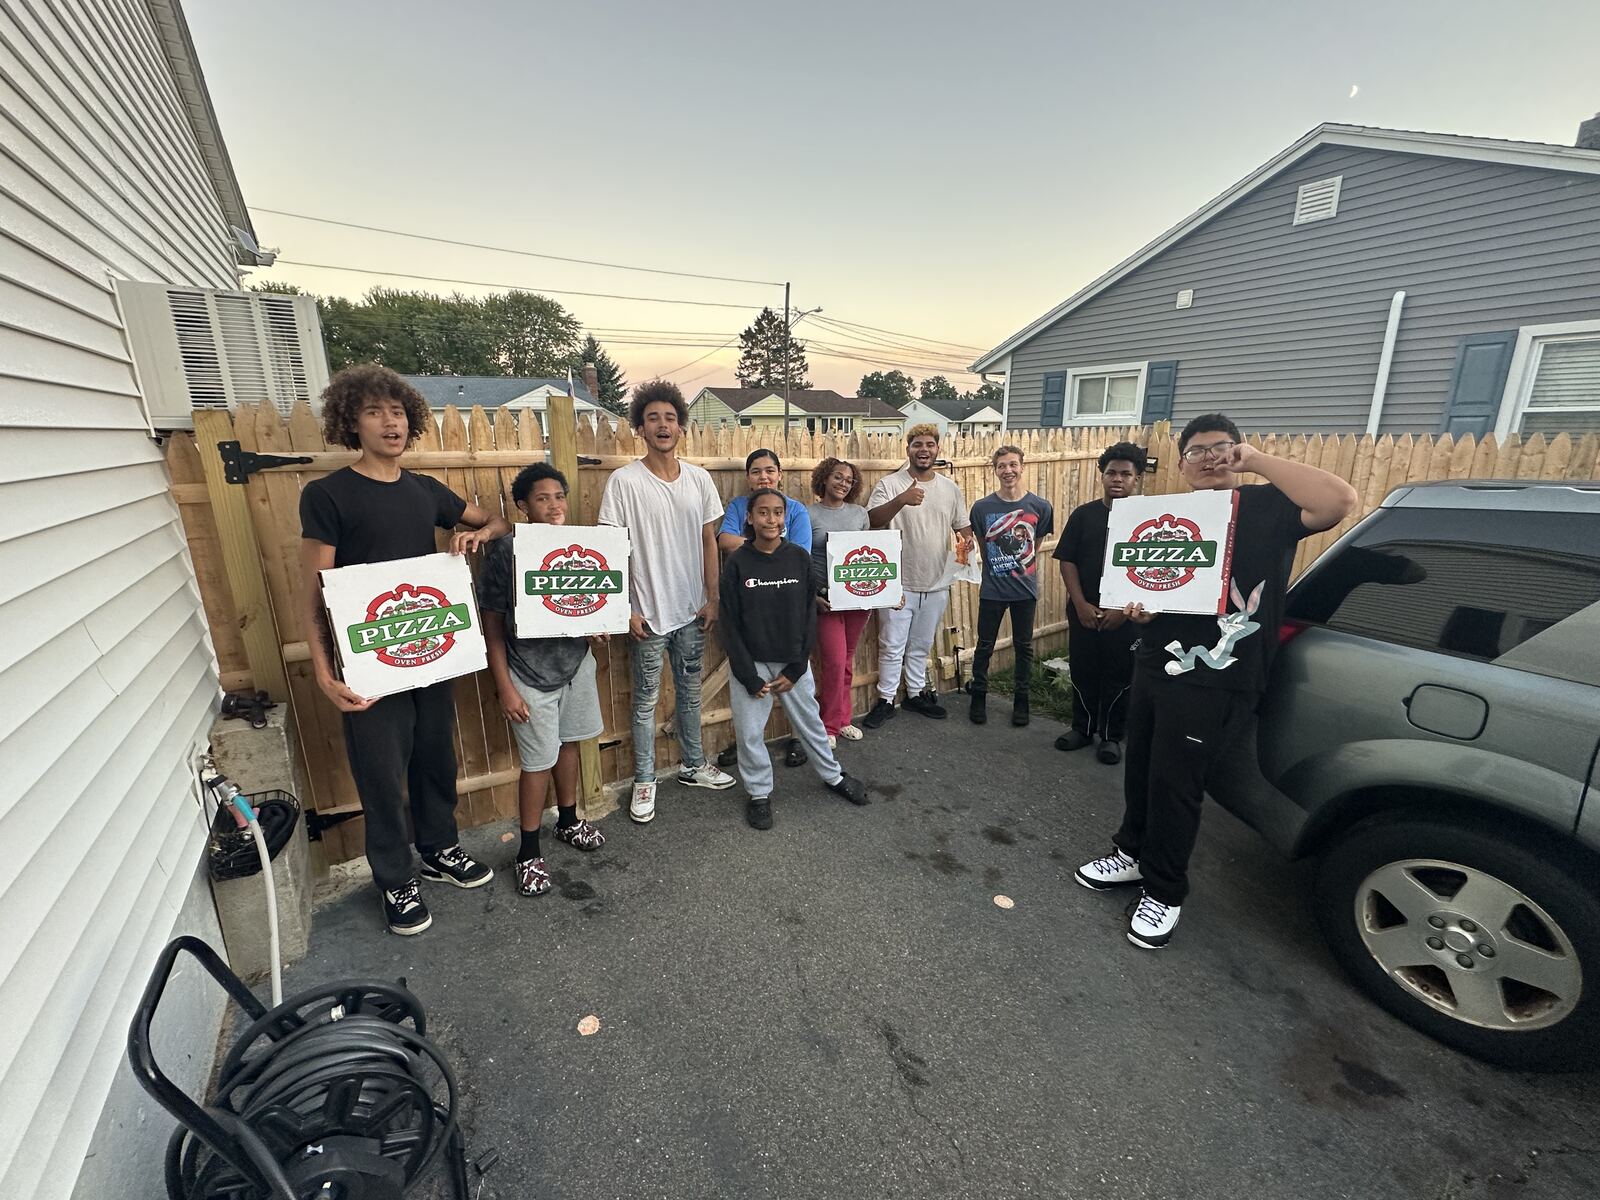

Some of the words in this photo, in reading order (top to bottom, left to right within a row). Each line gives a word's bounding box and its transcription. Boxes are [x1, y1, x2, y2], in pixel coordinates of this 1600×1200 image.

[1118, 546, 1209, 562] PIZZA
[838, 566, 894, 579] PIZZA
[532, 575, 617, 590] PIZZA
[745, 578, 799, 588] Champion
[1137, 579, 1154, 589] OVEN
[1158, 581, 1180, 590] FRESH
[555, 606, 573, 615] OVEN
[576, 606, 596, 615] FRESH
[358, 611, 465, 647] PIZZA
[394, 658, 417, 666] OVEN
[421, 649, 444, 663] FRESH
